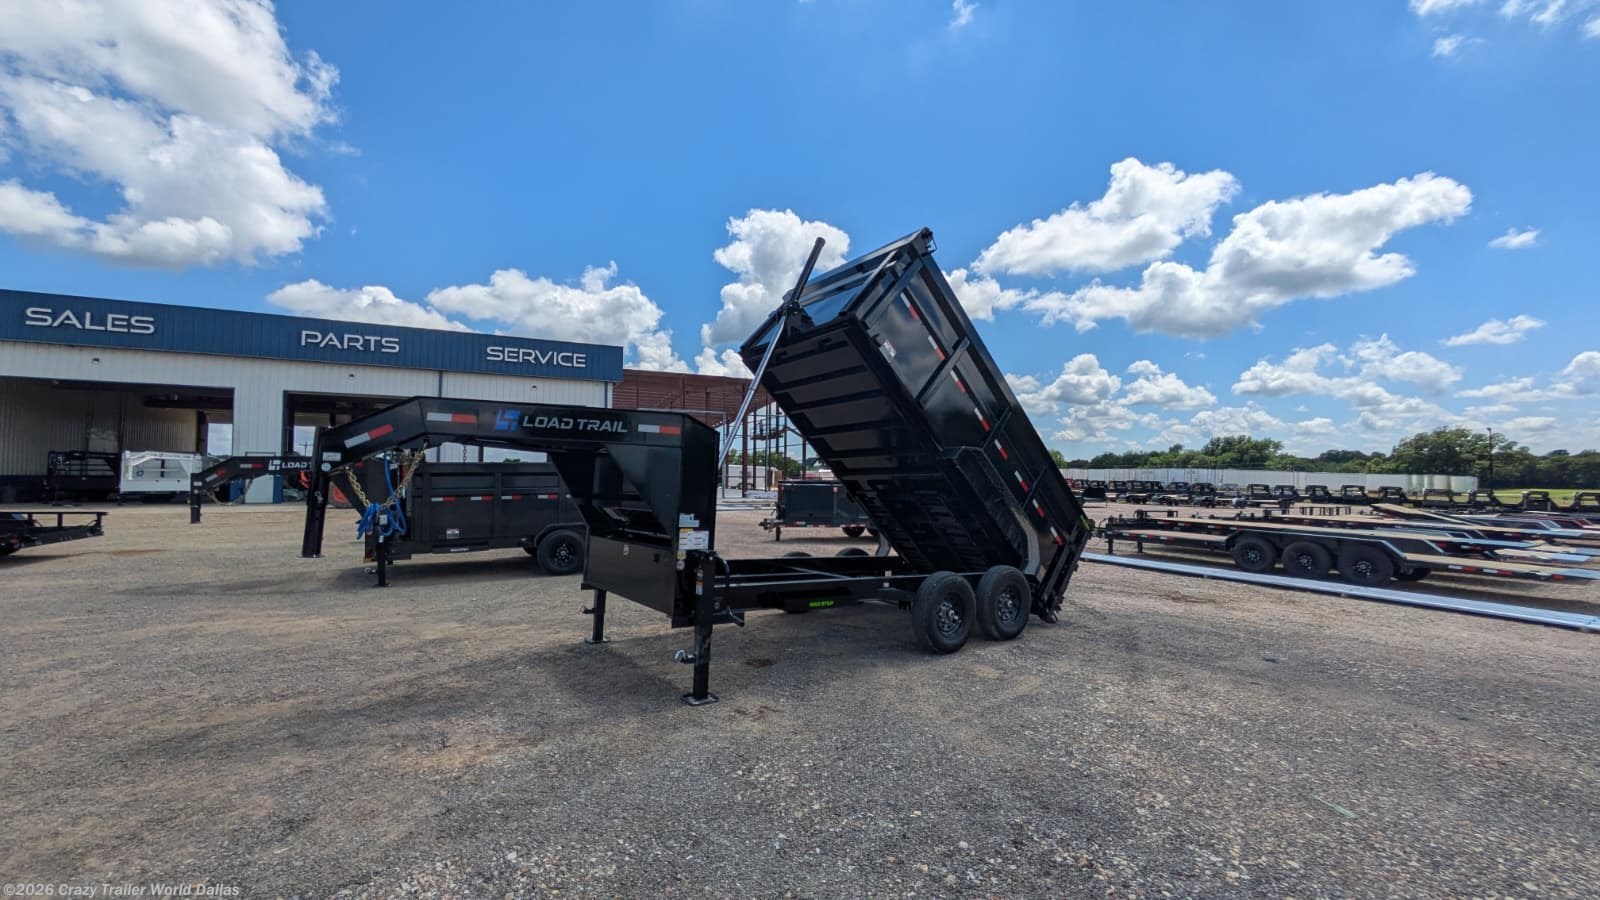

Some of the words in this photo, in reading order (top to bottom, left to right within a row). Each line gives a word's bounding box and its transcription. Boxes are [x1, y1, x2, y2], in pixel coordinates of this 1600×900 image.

[25, 307, 155, 334] SALES
[300, 330, 400, 353] PARTS
[486, 346, 586, 368] SERVICE
[522, 415, 573, 430] LOAD
[577, 418, 628, 433] TRAIL
[281, 461, 307, 469] LOAD
